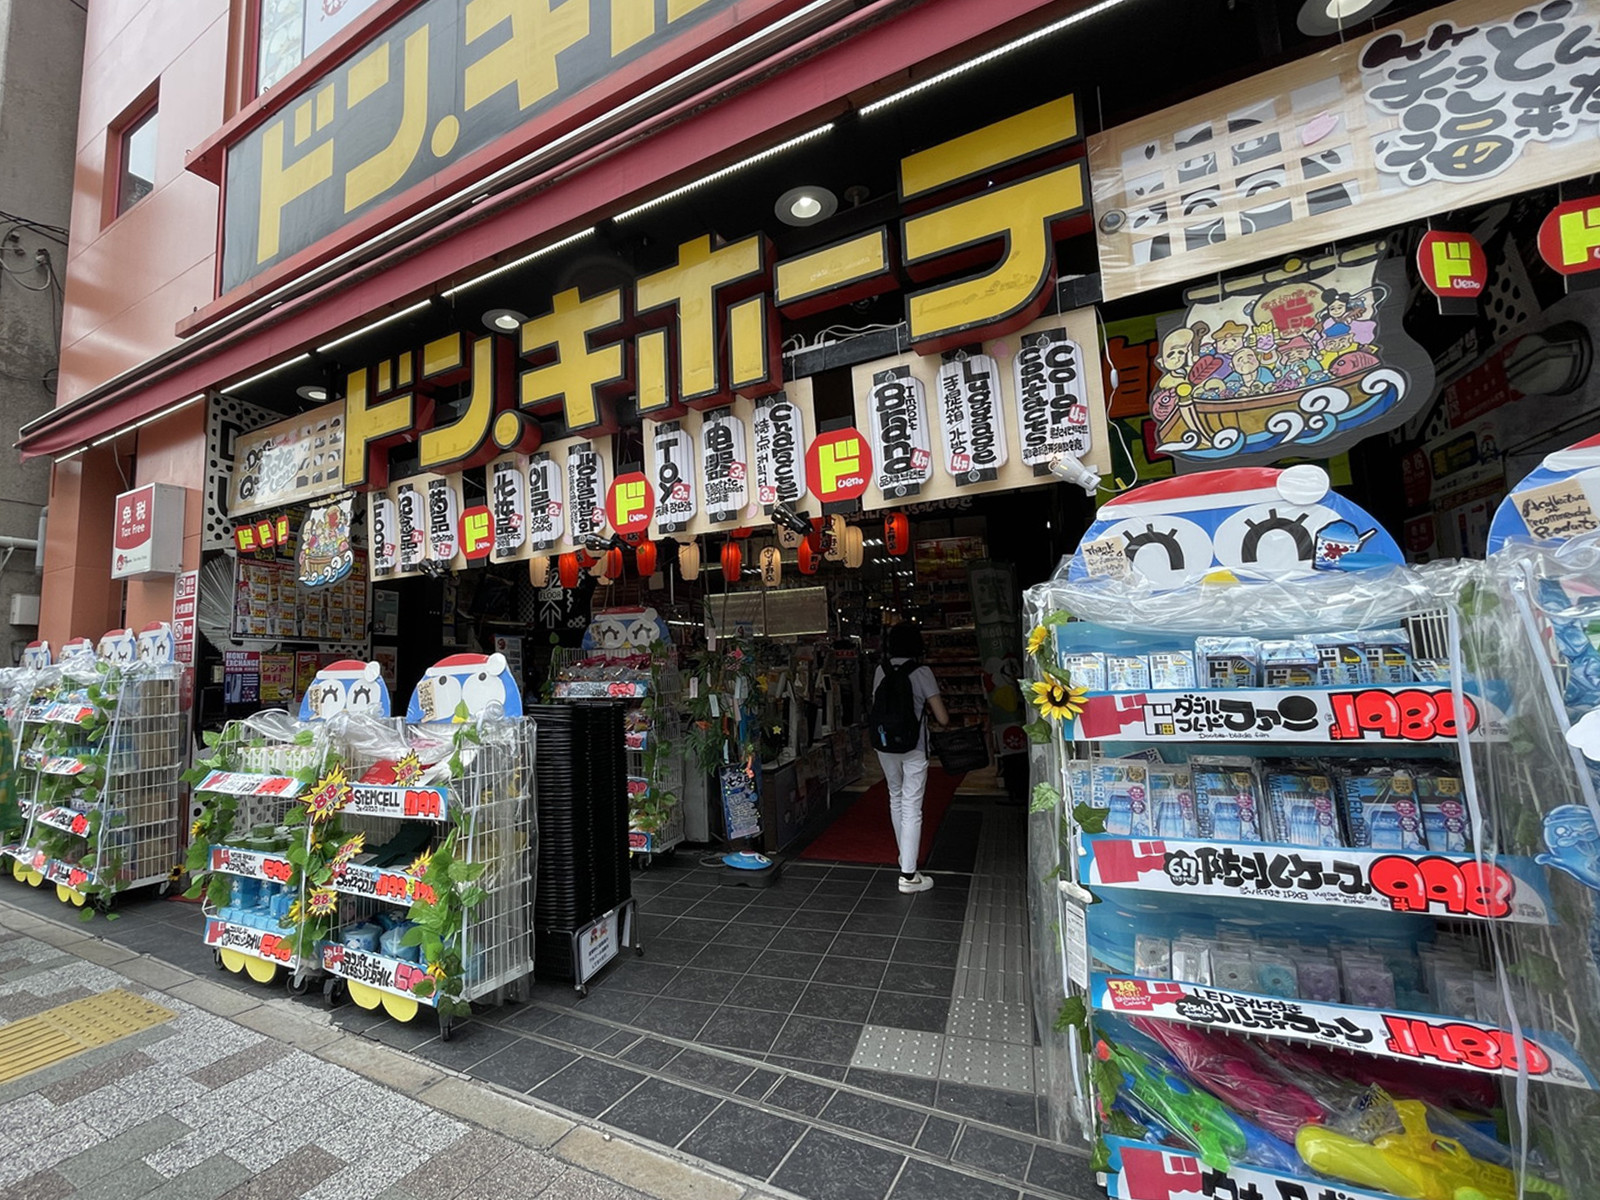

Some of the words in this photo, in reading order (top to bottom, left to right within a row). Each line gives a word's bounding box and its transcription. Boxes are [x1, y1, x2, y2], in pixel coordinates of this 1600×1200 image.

[1432, 242, 1471, 288] ド
[655, 439, 682, 503] TOY
[819, 438, 860, 494] ド
[122, 500, 147, 526] 免税
[616, 480, 647, 526] ド
[132, 523, 146, 535] Free
[238, 529, 254, 550] ド
[464, 512, 489, 553] ド
[225, 659, 260, 667] EXCHANGE
[226, 652, 248, 660] MONEY
[1330, 689, 1480, 741] 1980
[1368, 854, 1516, 918] 998
[1382, 1015, 1553, 1076] 1480
